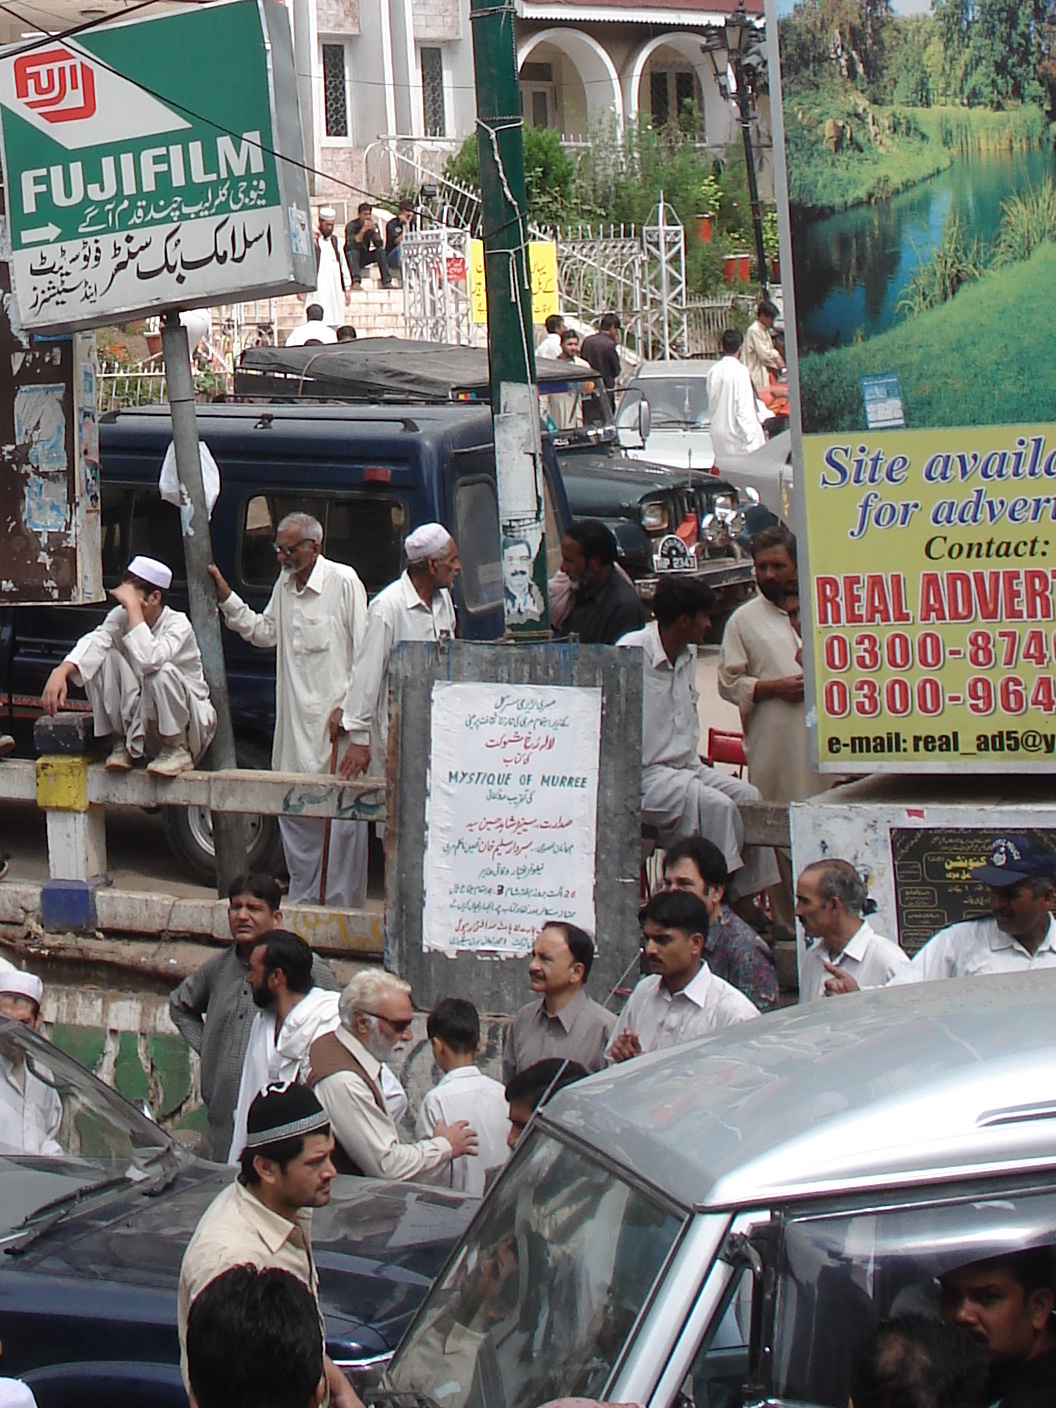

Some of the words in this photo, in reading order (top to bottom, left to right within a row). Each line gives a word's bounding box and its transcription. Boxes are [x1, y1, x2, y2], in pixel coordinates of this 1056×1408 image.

[21, 130, 266, 215] FUJIFILM
[115, 200, 147, 231] قدم
[146, 194, 183, 221] چند
[820, 444, 909, 488] Site
[849, 490, 921, 538] for
[924, 535, 1050, 560] Contact:
[815, 573, 913, 626] REAL
[920, 568, 1056, 624] ADVER
[824, 629, 1056, 672] 0300-874
[827, 731, 908, 755] e-mail:
[448, 770, 512, 786] MYSTIQUE
[519, 774, 533, 786] OF
[540, 774, 588, 789] MURREE
